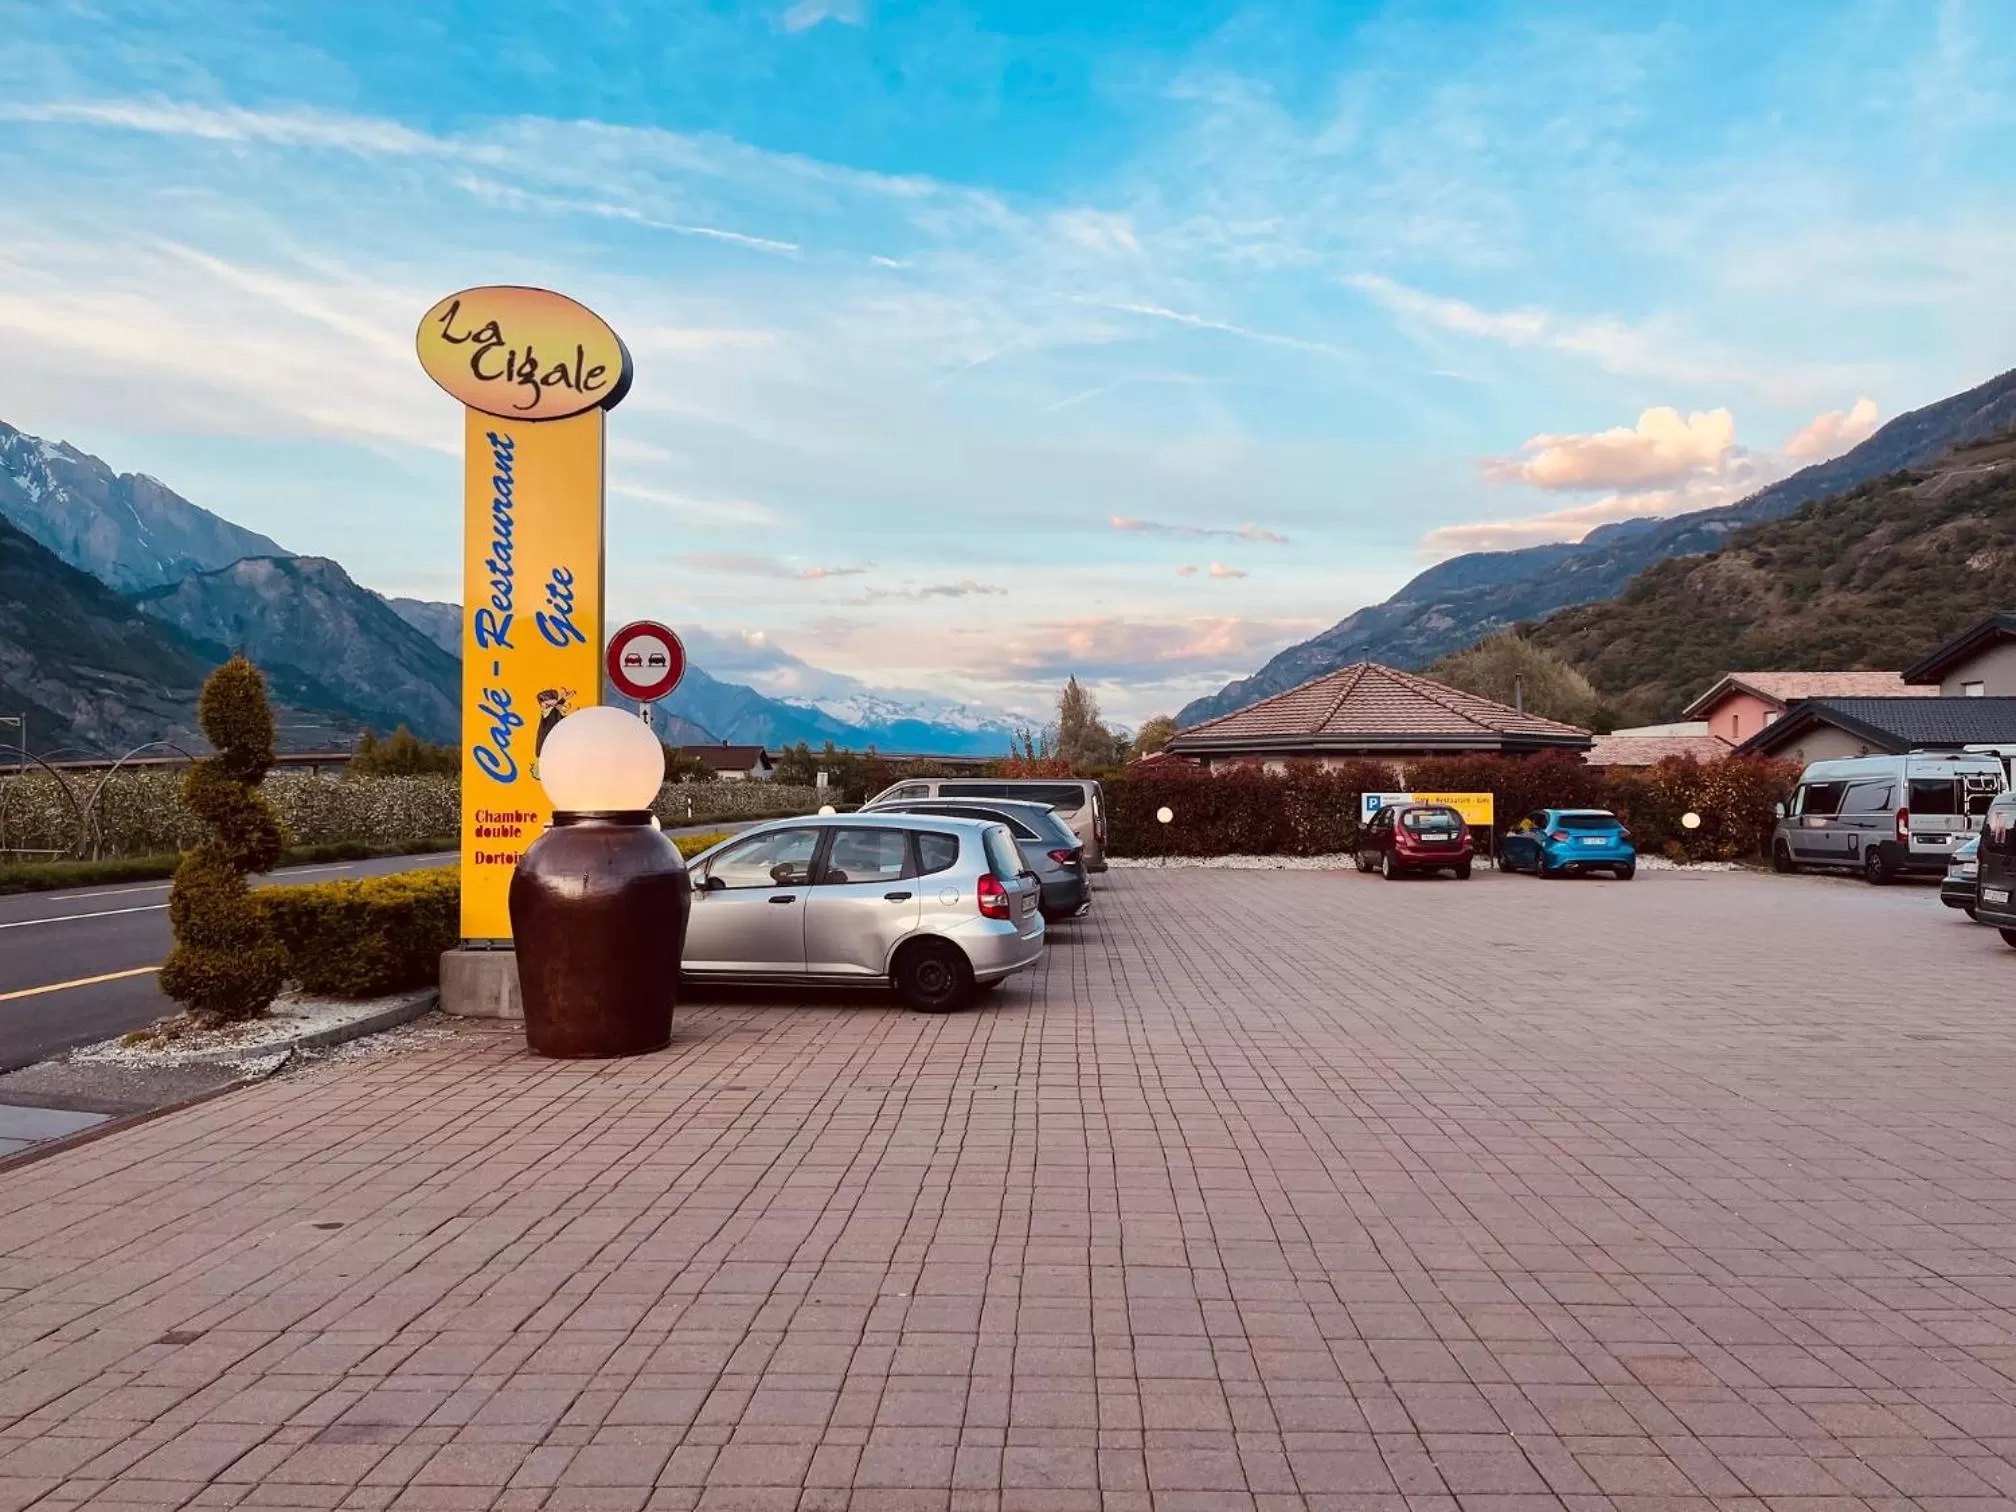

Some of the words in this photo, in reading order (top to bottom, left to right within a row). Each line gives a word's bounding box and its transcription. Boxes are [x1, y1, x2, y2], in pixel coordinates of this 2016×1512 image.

[438, 299, 505, 346] La
[470, 343, 608, 411] Cigale
[474, 432, 515, 650] Restaurant
[473, 688, 524, 784] Café
[475, 809, 538, 823] Chambre
[475, 825, 522, 838] double
